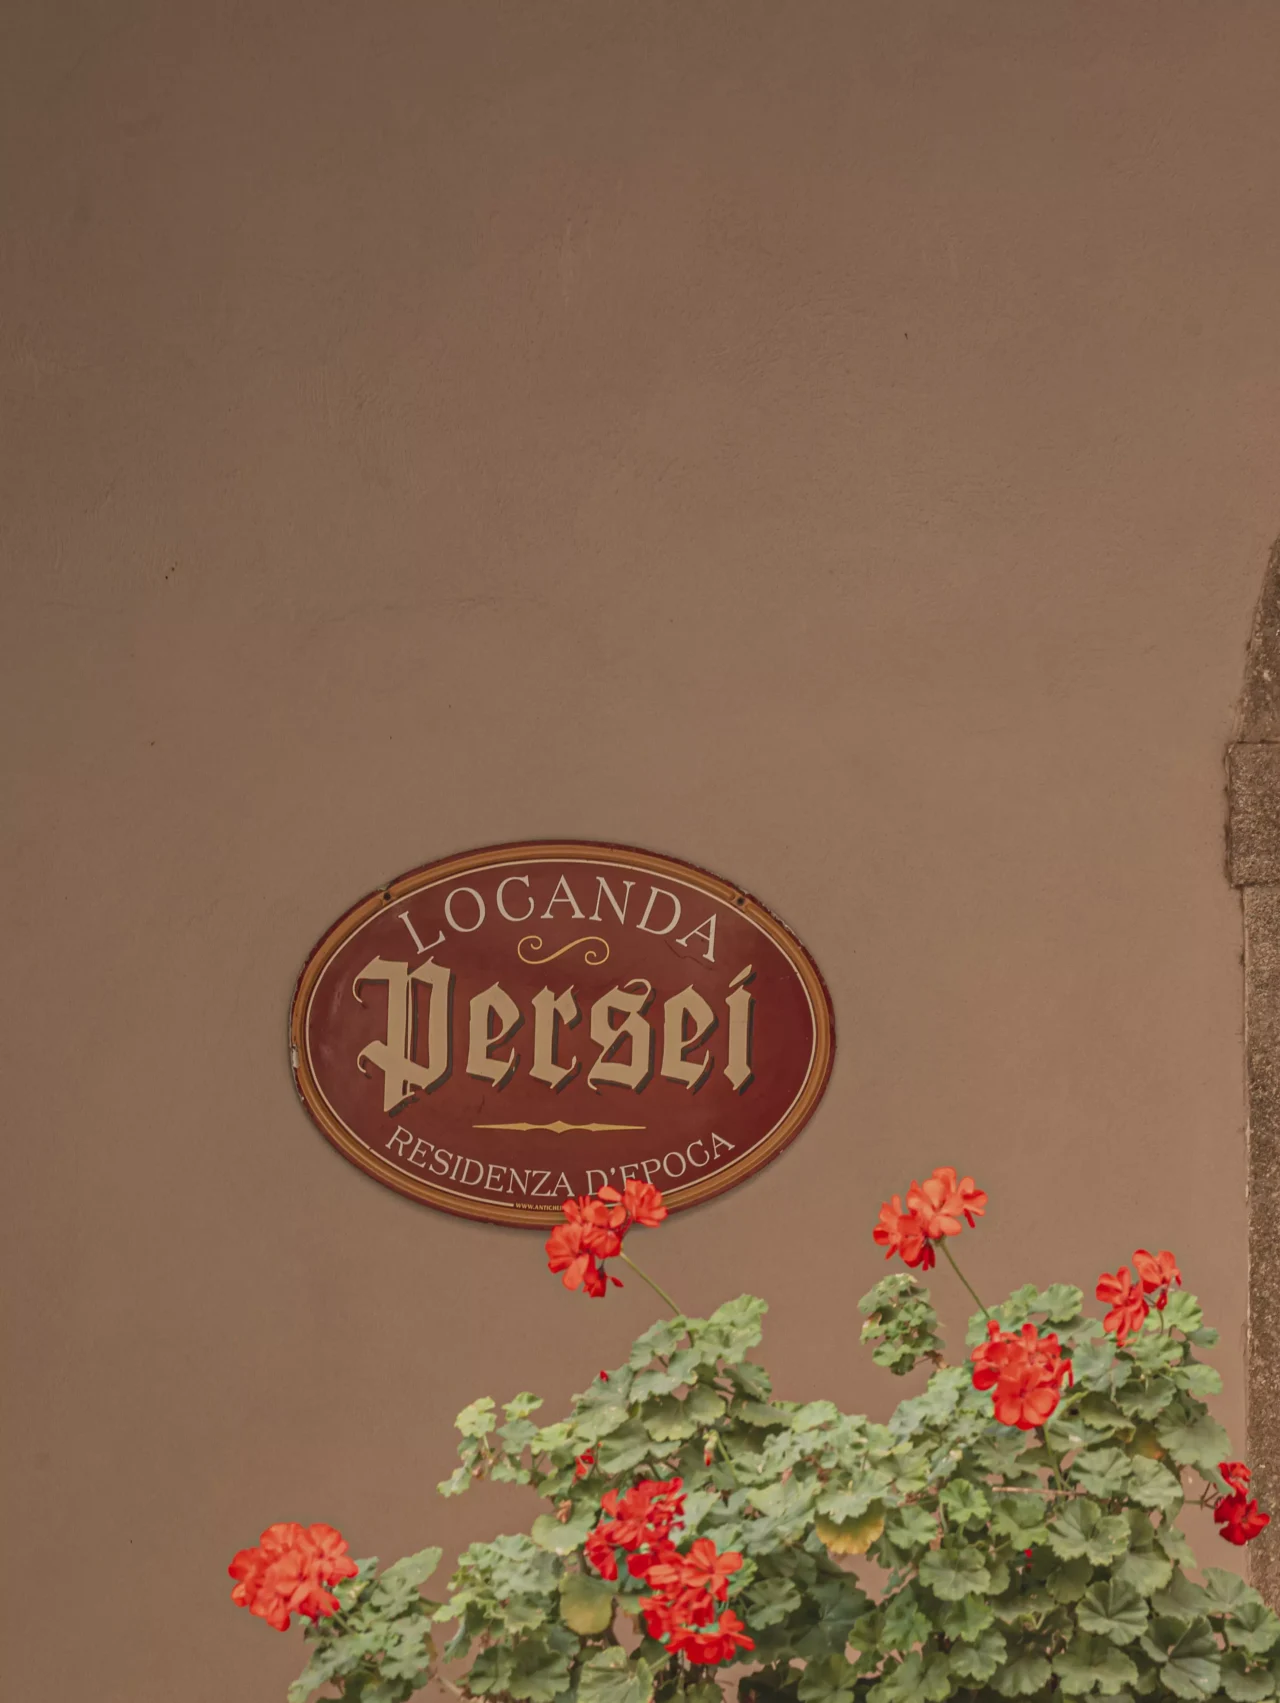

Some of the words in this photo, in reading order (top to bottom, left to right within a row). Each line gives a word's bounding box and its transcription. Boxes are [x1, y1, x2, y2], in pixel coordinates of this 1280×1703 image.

[397, 873, 719, 964] LOCANDA
[352, 954, 757, 1115] Persei
[384, 1124, 576, 1198] RESIDENZA
